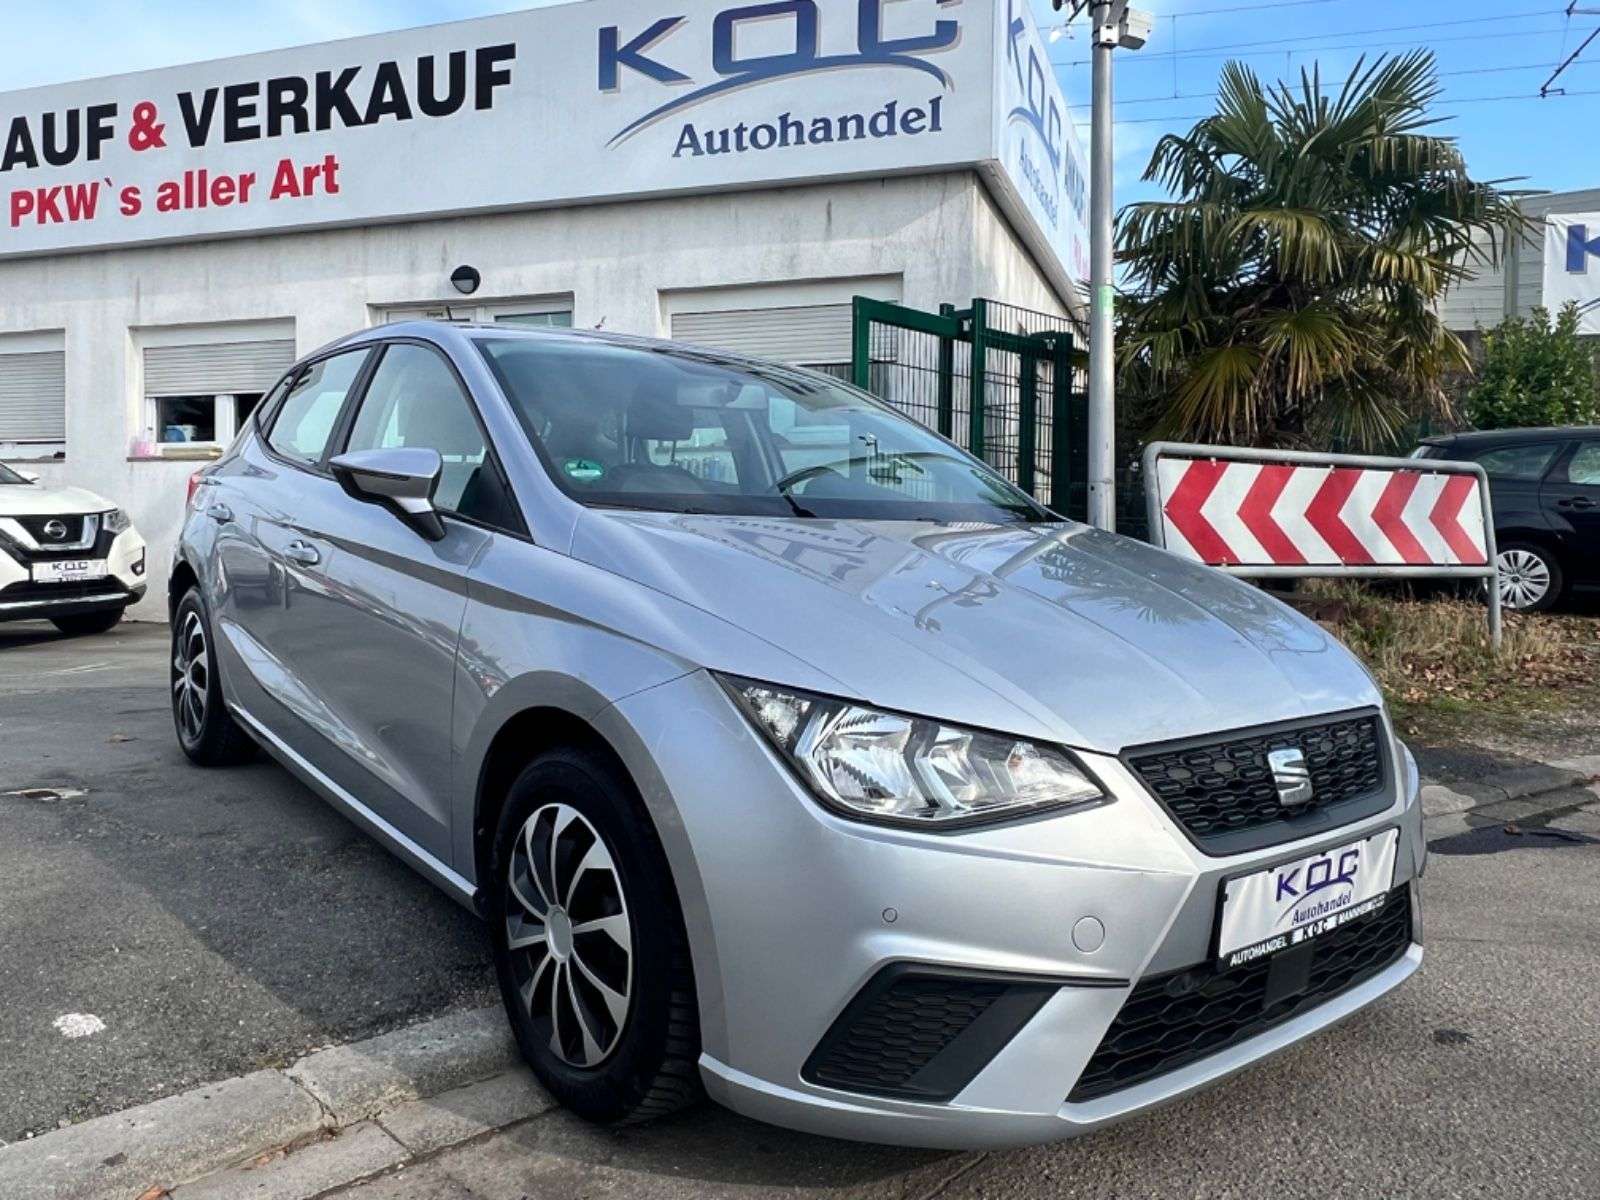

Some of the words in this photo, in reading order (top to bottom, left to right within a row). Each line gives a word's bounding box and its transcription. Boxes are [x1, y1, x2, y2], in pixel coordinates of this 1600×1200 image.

[0, 103, 117, 171] AUF
[128, 101, 167, 152] &
[177, 42, 516, 148] VERKAUF
[672, 96, 942, 158] Autohandel
[156, 170, 256, 212] aller
[269, 154, 339, 201] Art
[1291, 890, 1352, 926] Autohandel
[1229, 935, 1288, 967] AUTOHANDEL
